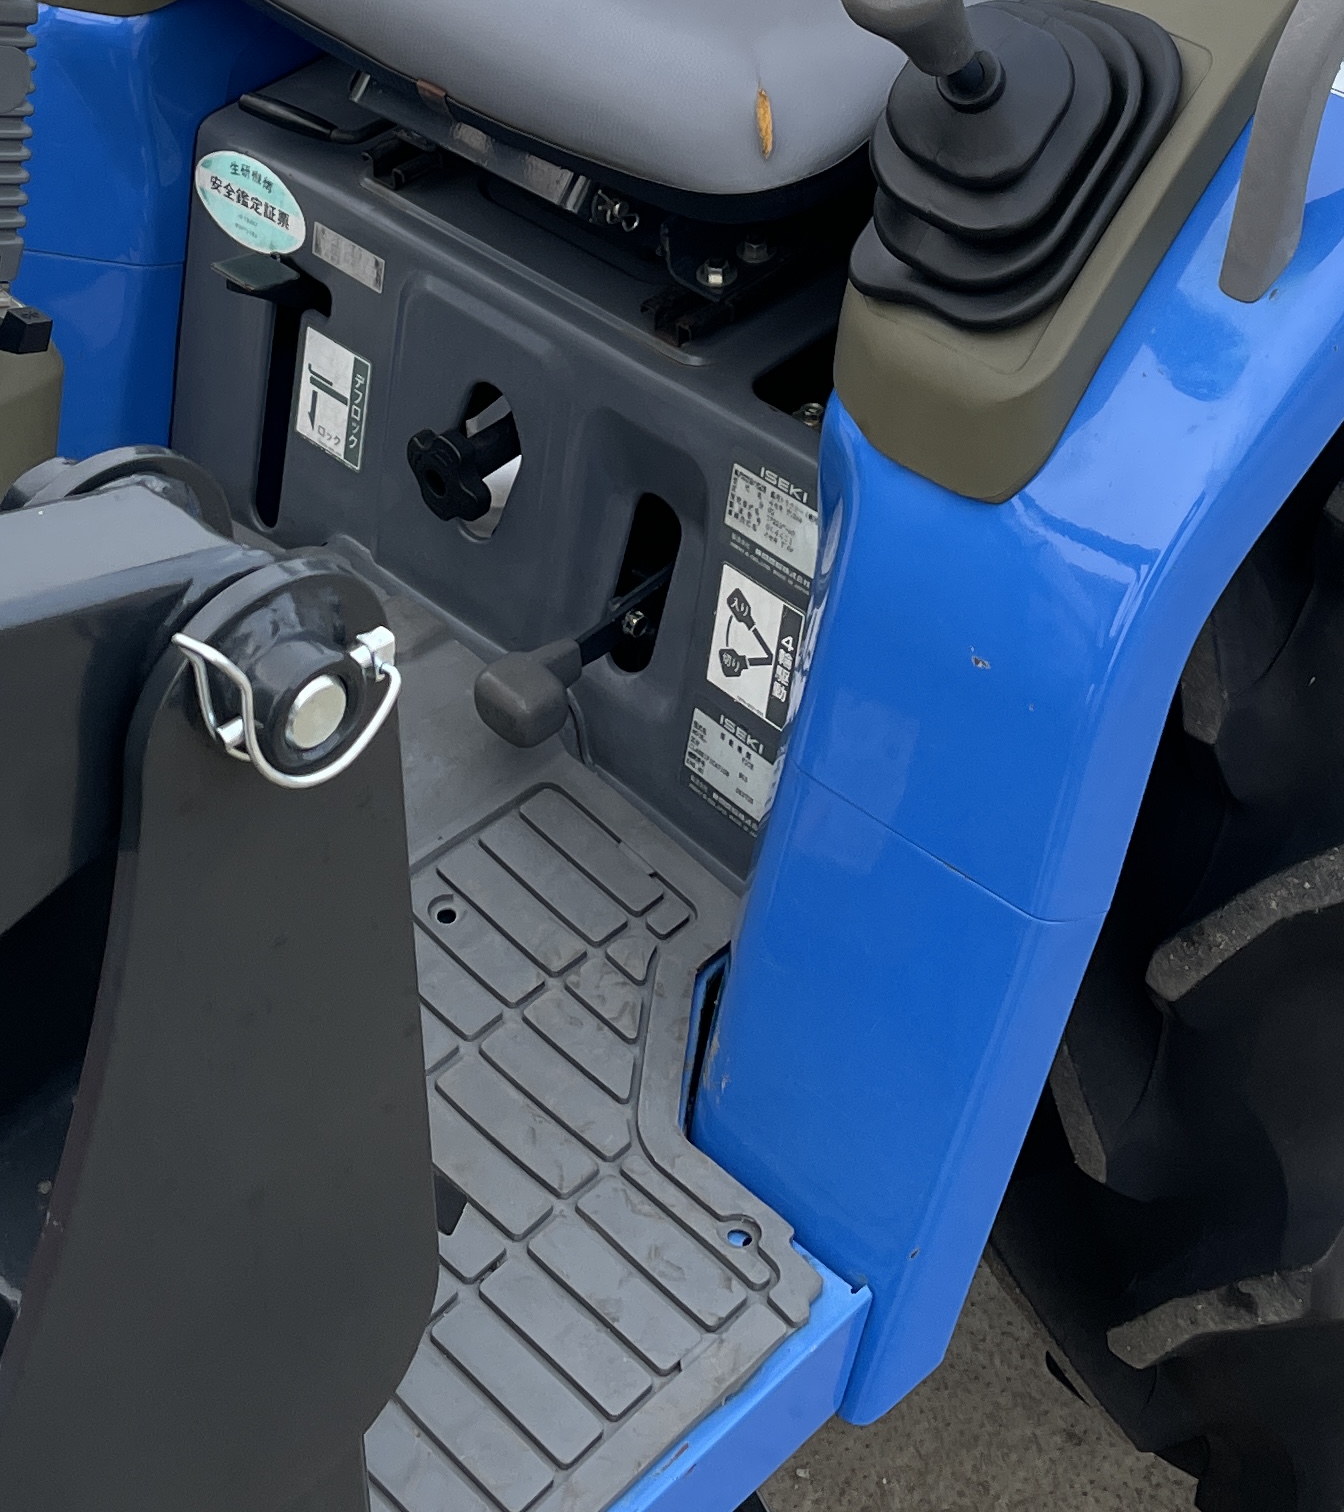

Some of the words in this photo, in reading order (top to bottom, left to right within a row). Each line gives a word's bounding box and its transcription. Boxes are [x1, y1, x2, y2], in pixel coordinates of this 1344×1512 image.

[210, 175, 290, 230] 安全鑑定証票
[347, 374, 366, 449] デフロック
[317, 424, 341, 447] ロック
[760, 466, 808, 504] ISEKI
[730, 597, 749, 616] 入り
[771, 635, 795, 703] 4輪駆動
[719, 714, 764, 755] ISEKI
